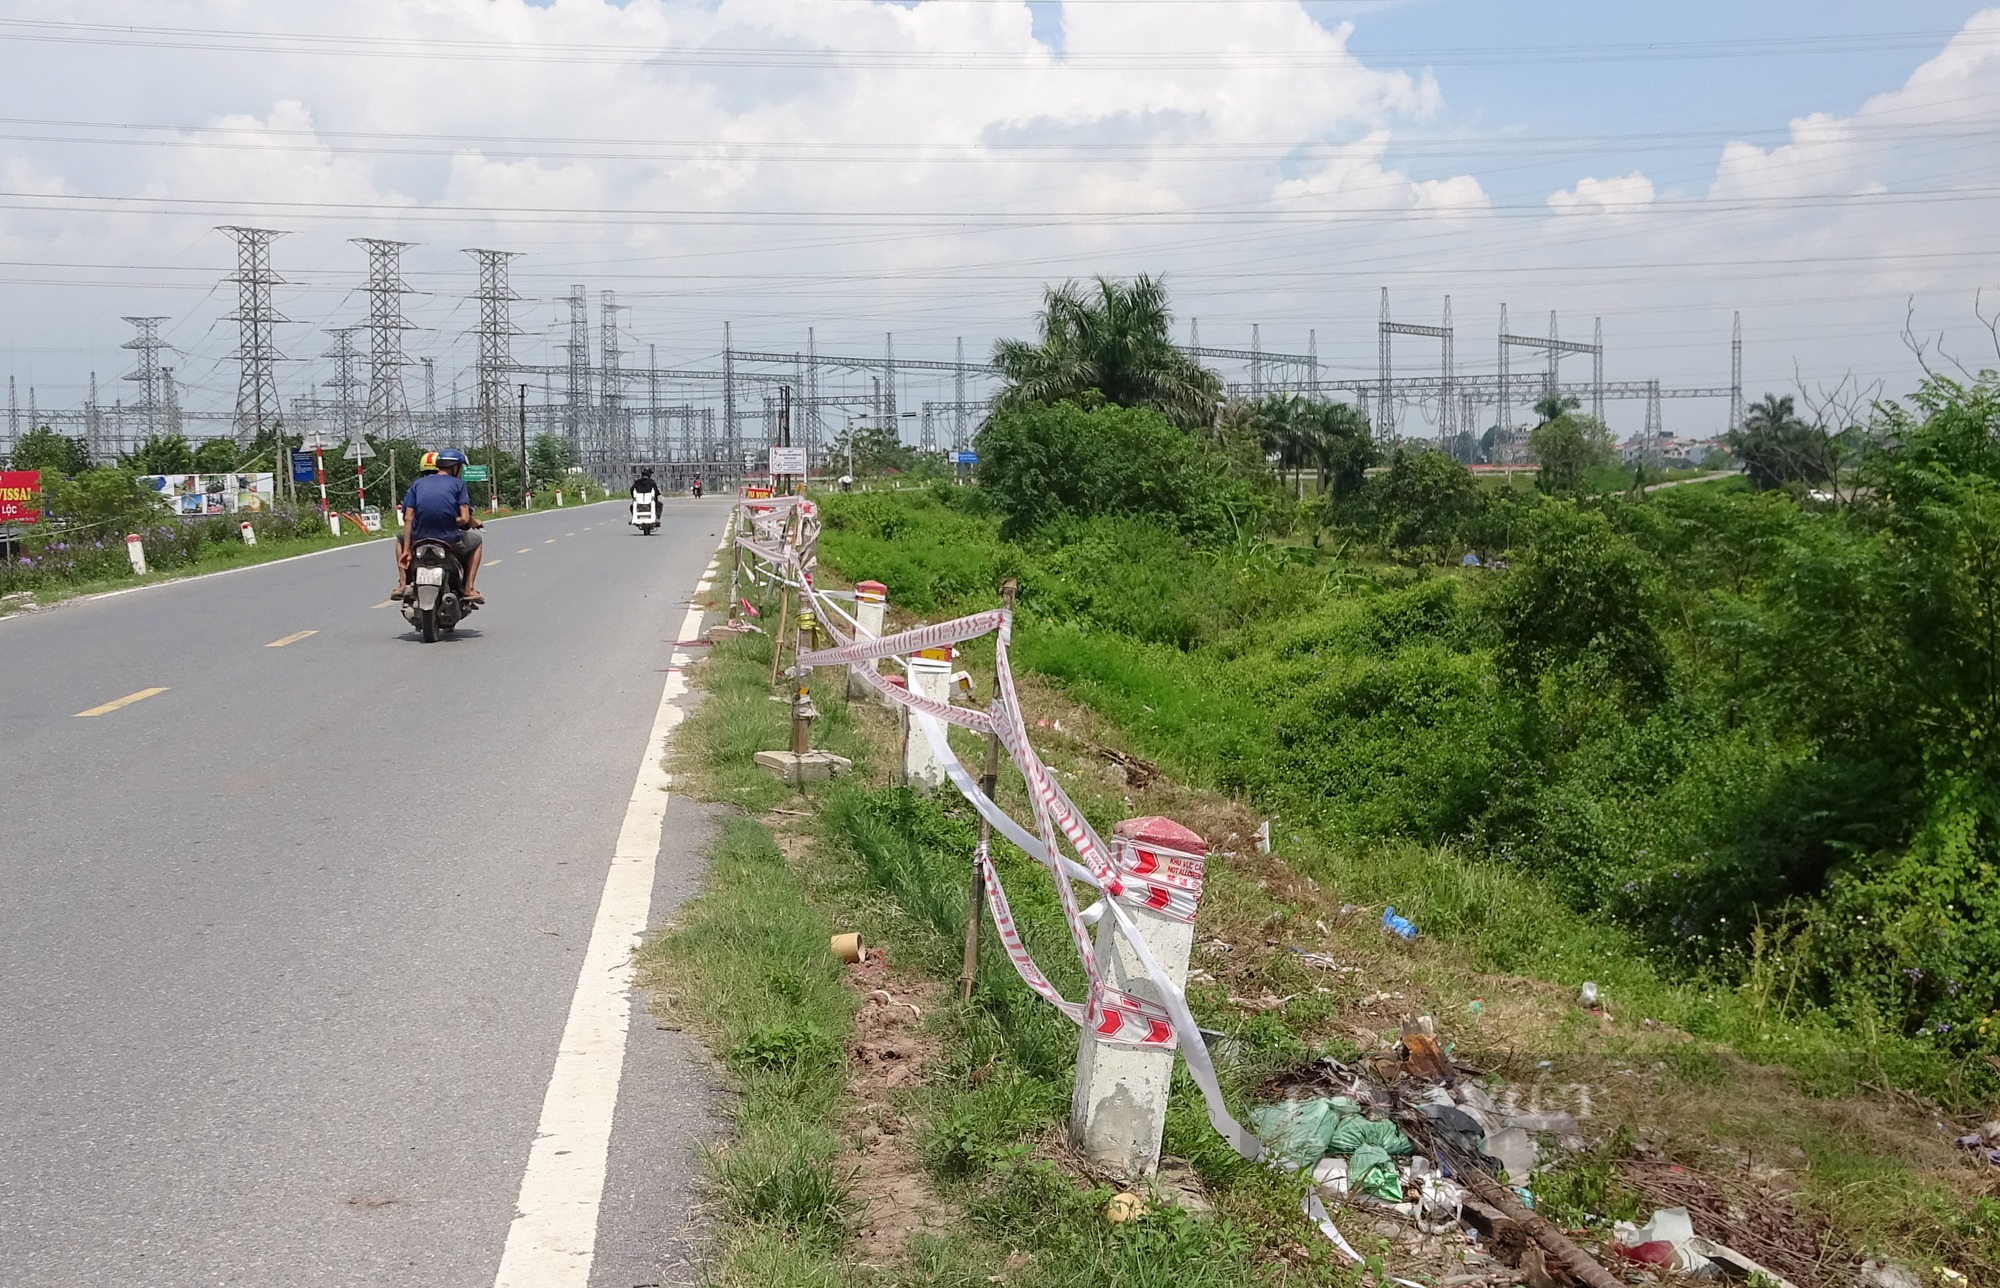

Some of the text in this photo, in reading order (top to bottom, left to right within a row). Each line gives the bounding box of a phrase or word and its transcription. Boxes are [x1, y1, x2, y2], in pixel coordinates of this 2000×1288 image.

[1, 504, 18, 516] LỘC
[1169, 857, 1182, 866] KHU
[1167, 865, 1201, 880] NOT ALLOWED
